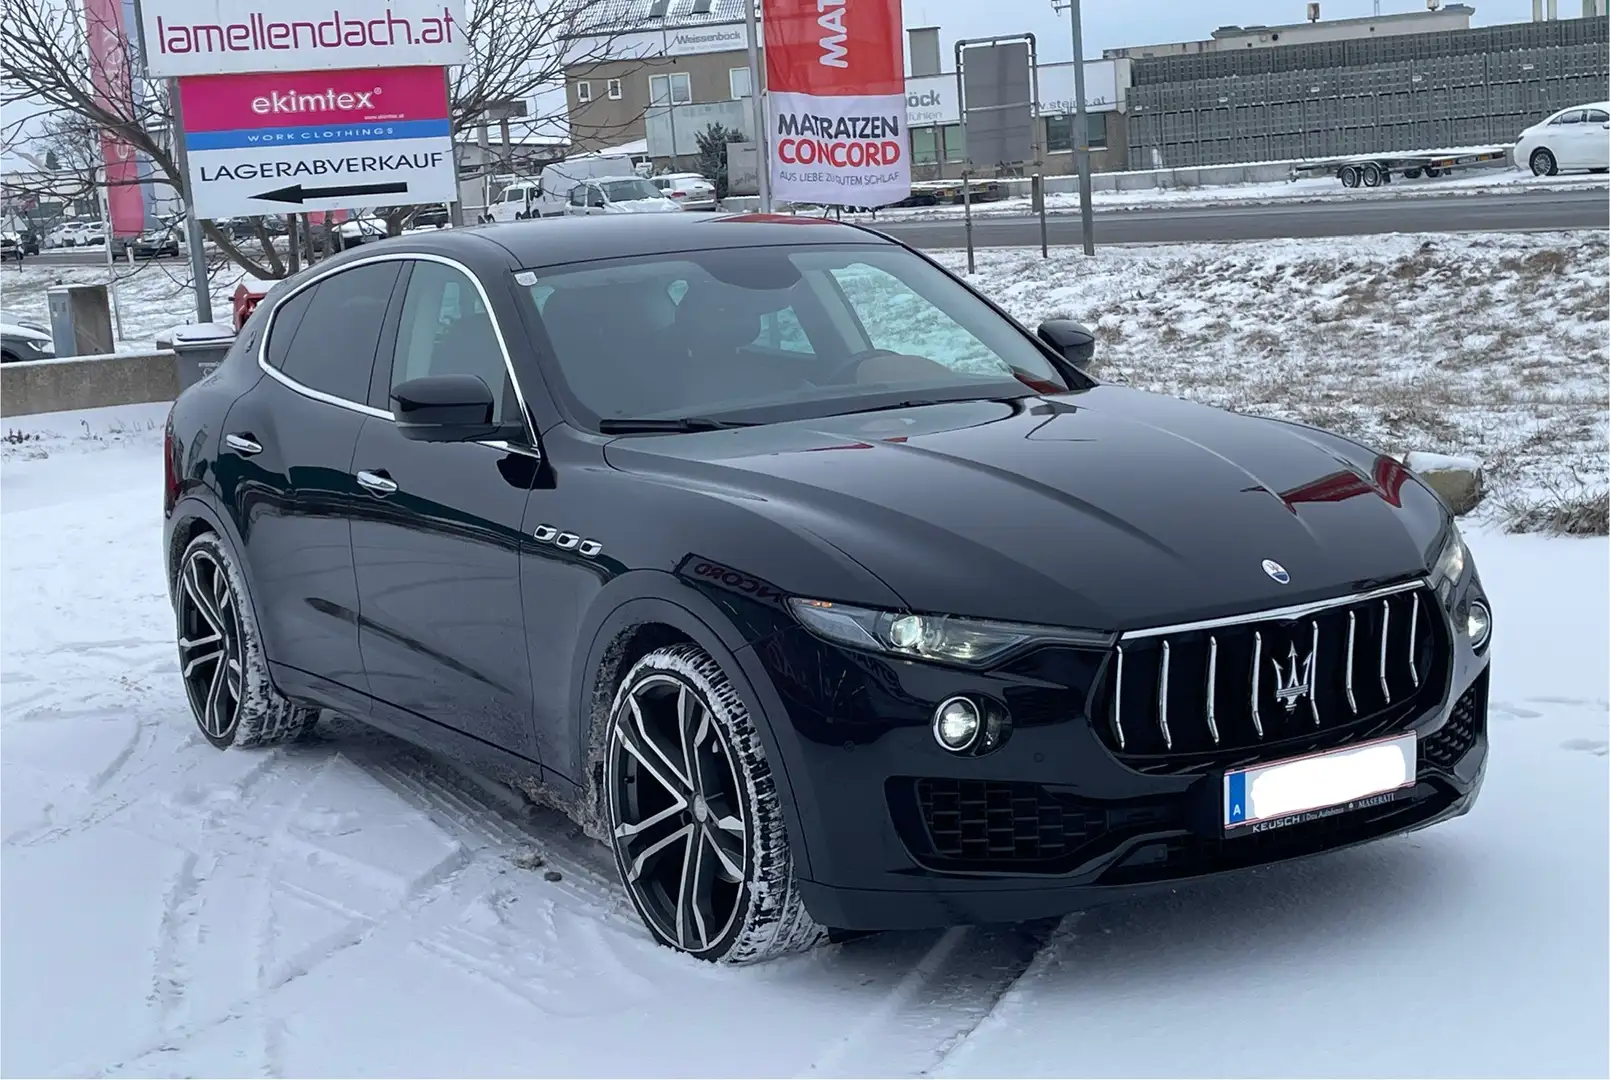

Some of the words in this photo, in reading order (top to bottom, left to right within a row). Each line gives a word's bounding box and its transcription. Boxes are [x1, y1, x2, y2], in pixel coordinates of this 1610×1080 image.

[156, 7, 454, 54] lamellendach.at
[676, 31, 741, 45] Weissenböck
[817, 0, 848, 69] MAT
[905, 89, 941, 109] öck
[248, 133, 294, 142] WORK
[301, 128, 394, 139] CLOTHINGS
[778, 113, 899, 139] MATRATZEN
[778, 138, 900, 168] CONCORD
[200, 152, 443, 181] LAGERABVERKAUF
[780, 170, 797, 182] AUS
[800, 172, 823, 183] LIEBE
[864, 171, 900, 185] SCHLAF
[1233, 804, 1241, 816] A
[1252, 816, 1300, 833] KEUSCH
[1358, 793, 1395, 808] MASERATI
